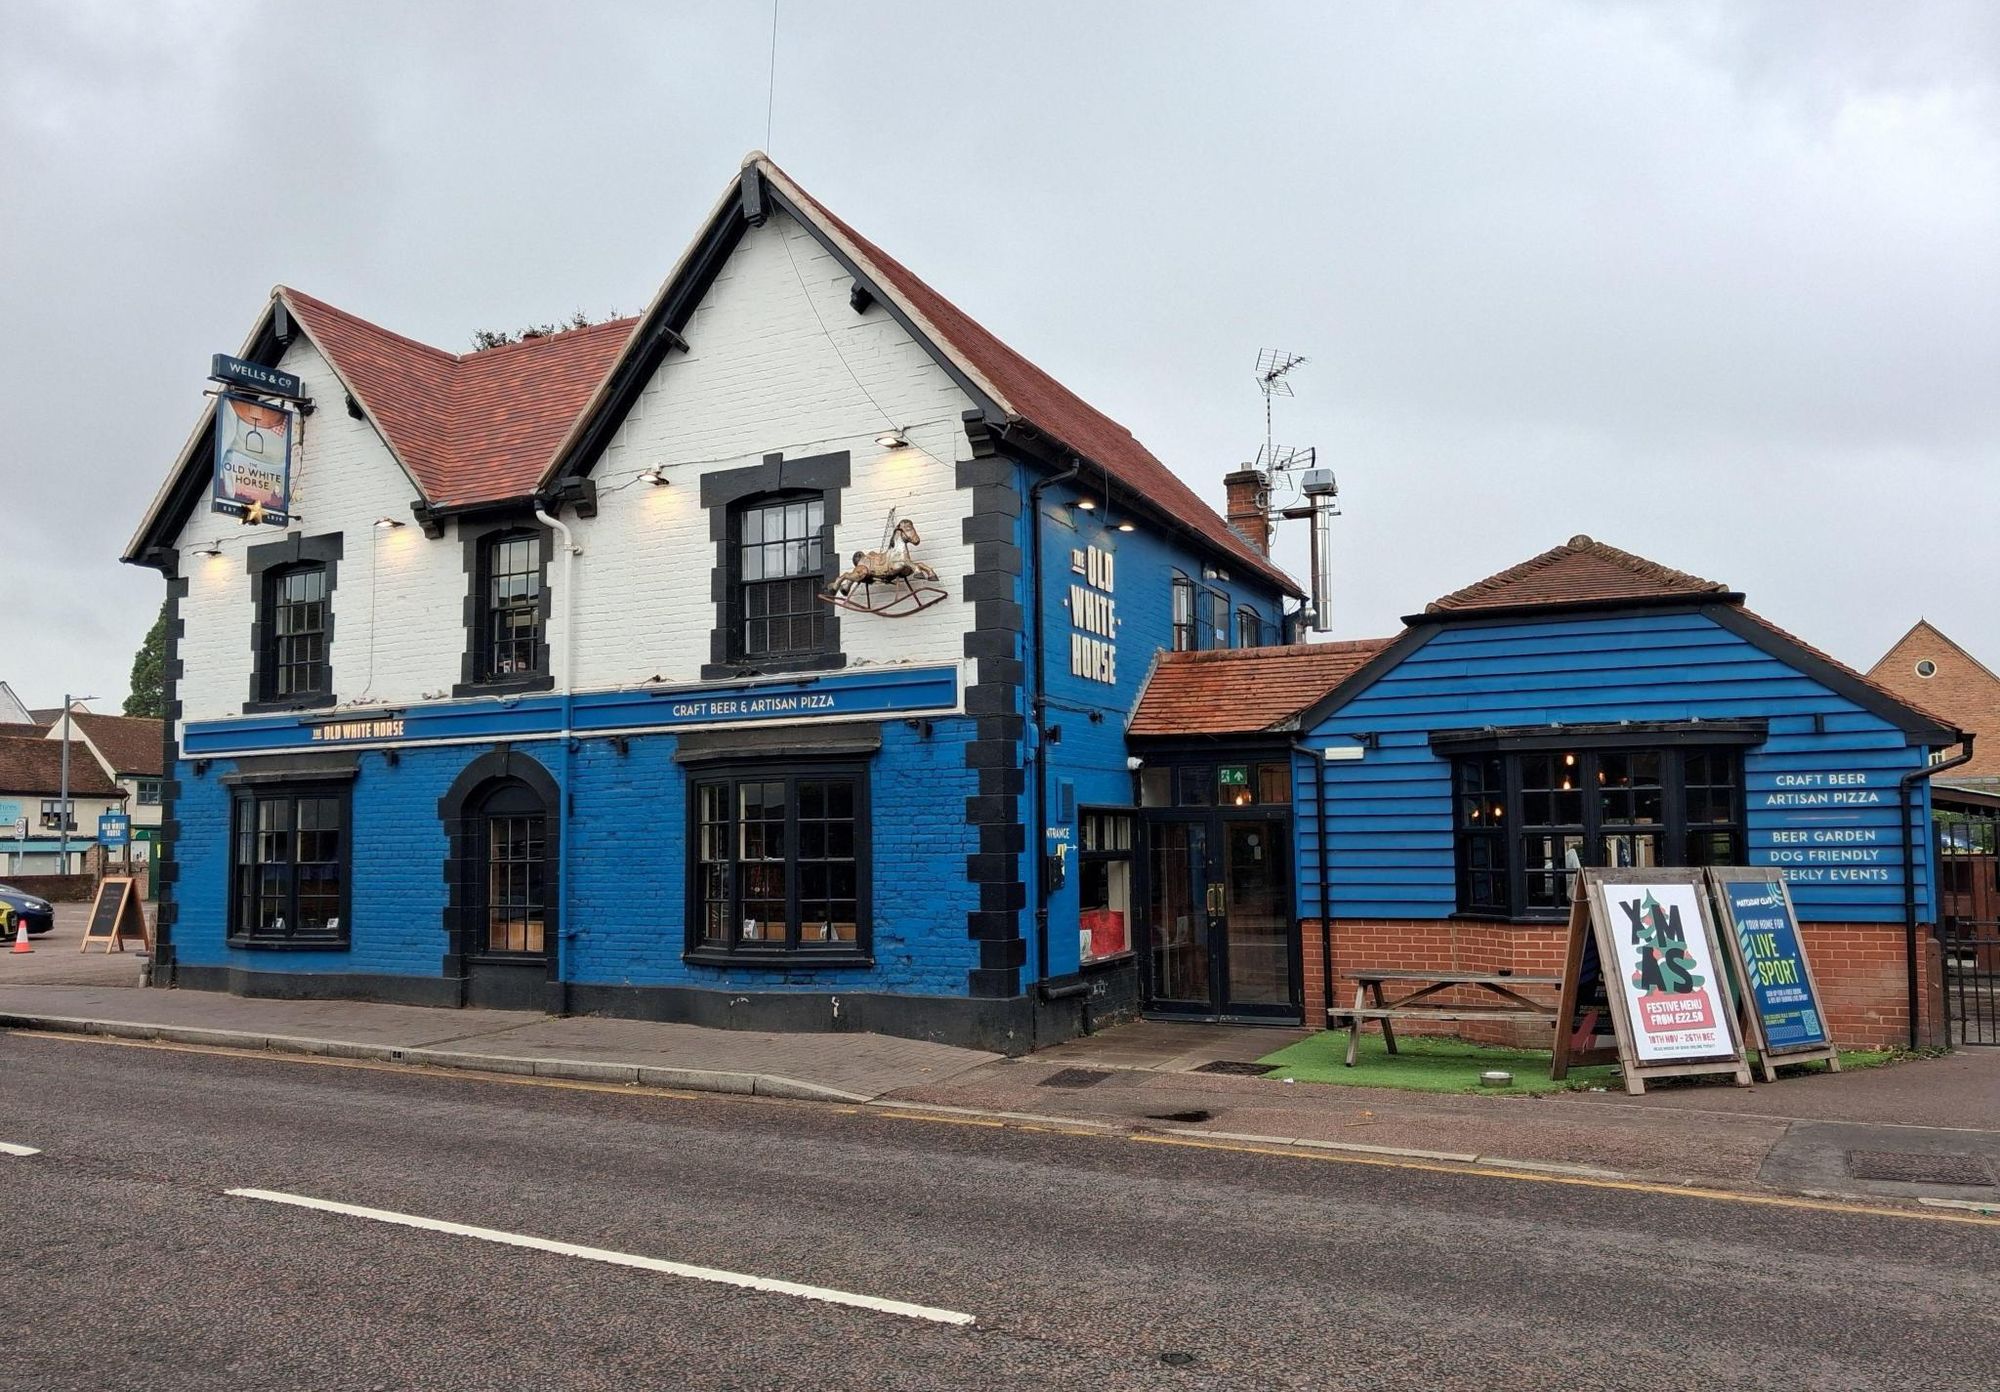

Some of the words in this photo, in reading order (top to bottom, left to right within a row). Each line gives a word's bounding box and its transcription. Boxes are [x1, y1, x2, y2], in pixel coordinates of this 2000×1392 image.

[230, 361, 267, 381] WELLS
[268, 374, 277, 384] &
[224, 462, 245, 474] OLD
[248, 467, 281, 483] WHITE
[235, 475, 270, 490] HORSE
[1087, 544, 1113, 593] OLD
[1070, 584, 1116, 639] WHITE
[1071, 632, 1116, 685] HORSE
[673, 703, 707, 717] CRAFT
[710, 701, 737, 715] BEER
[740, 701, 747, 713] &
[751, 697, 797, 712] ARTISAN
[800, 695, 835, 709] PIZZA
[324, 726, 341, 740] OLD
[343, 722, 372, 739] WHITE
[373, 720, 404, 737] HORSE
[1776, 775, 1821, 786] CRAFT
[1829, 774, 1866, 785] BEER
[1766, 793, 1828, 805] ARTISAN
[1834, 792, 1879, 803] PIZZA
[1046, 827, 1070, 839] NTRANCE
[1772, 832, 1808, 843] BEER
[1814, 830, 1876, 842] GARDEN
[1770, 850, 1803, 861] DOG
[1809, 849, 1879, 861] FRIENDLY
[1781, 869, 1824, 880] EEKLY
[1830, 868, 1888, 880] EVENTS
[1745, 919, 1760, 930] YOUR
[1760, 919, 1774, 930] HOME
[1774, 918, 1785, 929] FOR
[1750, 933, 1780, 959] LIVE
[1758, 960, 1799, 986] SPORT
[1646, 1001, 1680, 1014] FESTIVE
[1680, 999, 1703, 1012] MENU
[1651, 1013, 1674, 1025] FROM
[1675, 1011, 1704, 1024] £22.50
[1664, 1033, 1679, 1043] NOV
[1702, 1031, 1715, 1041] DEC
